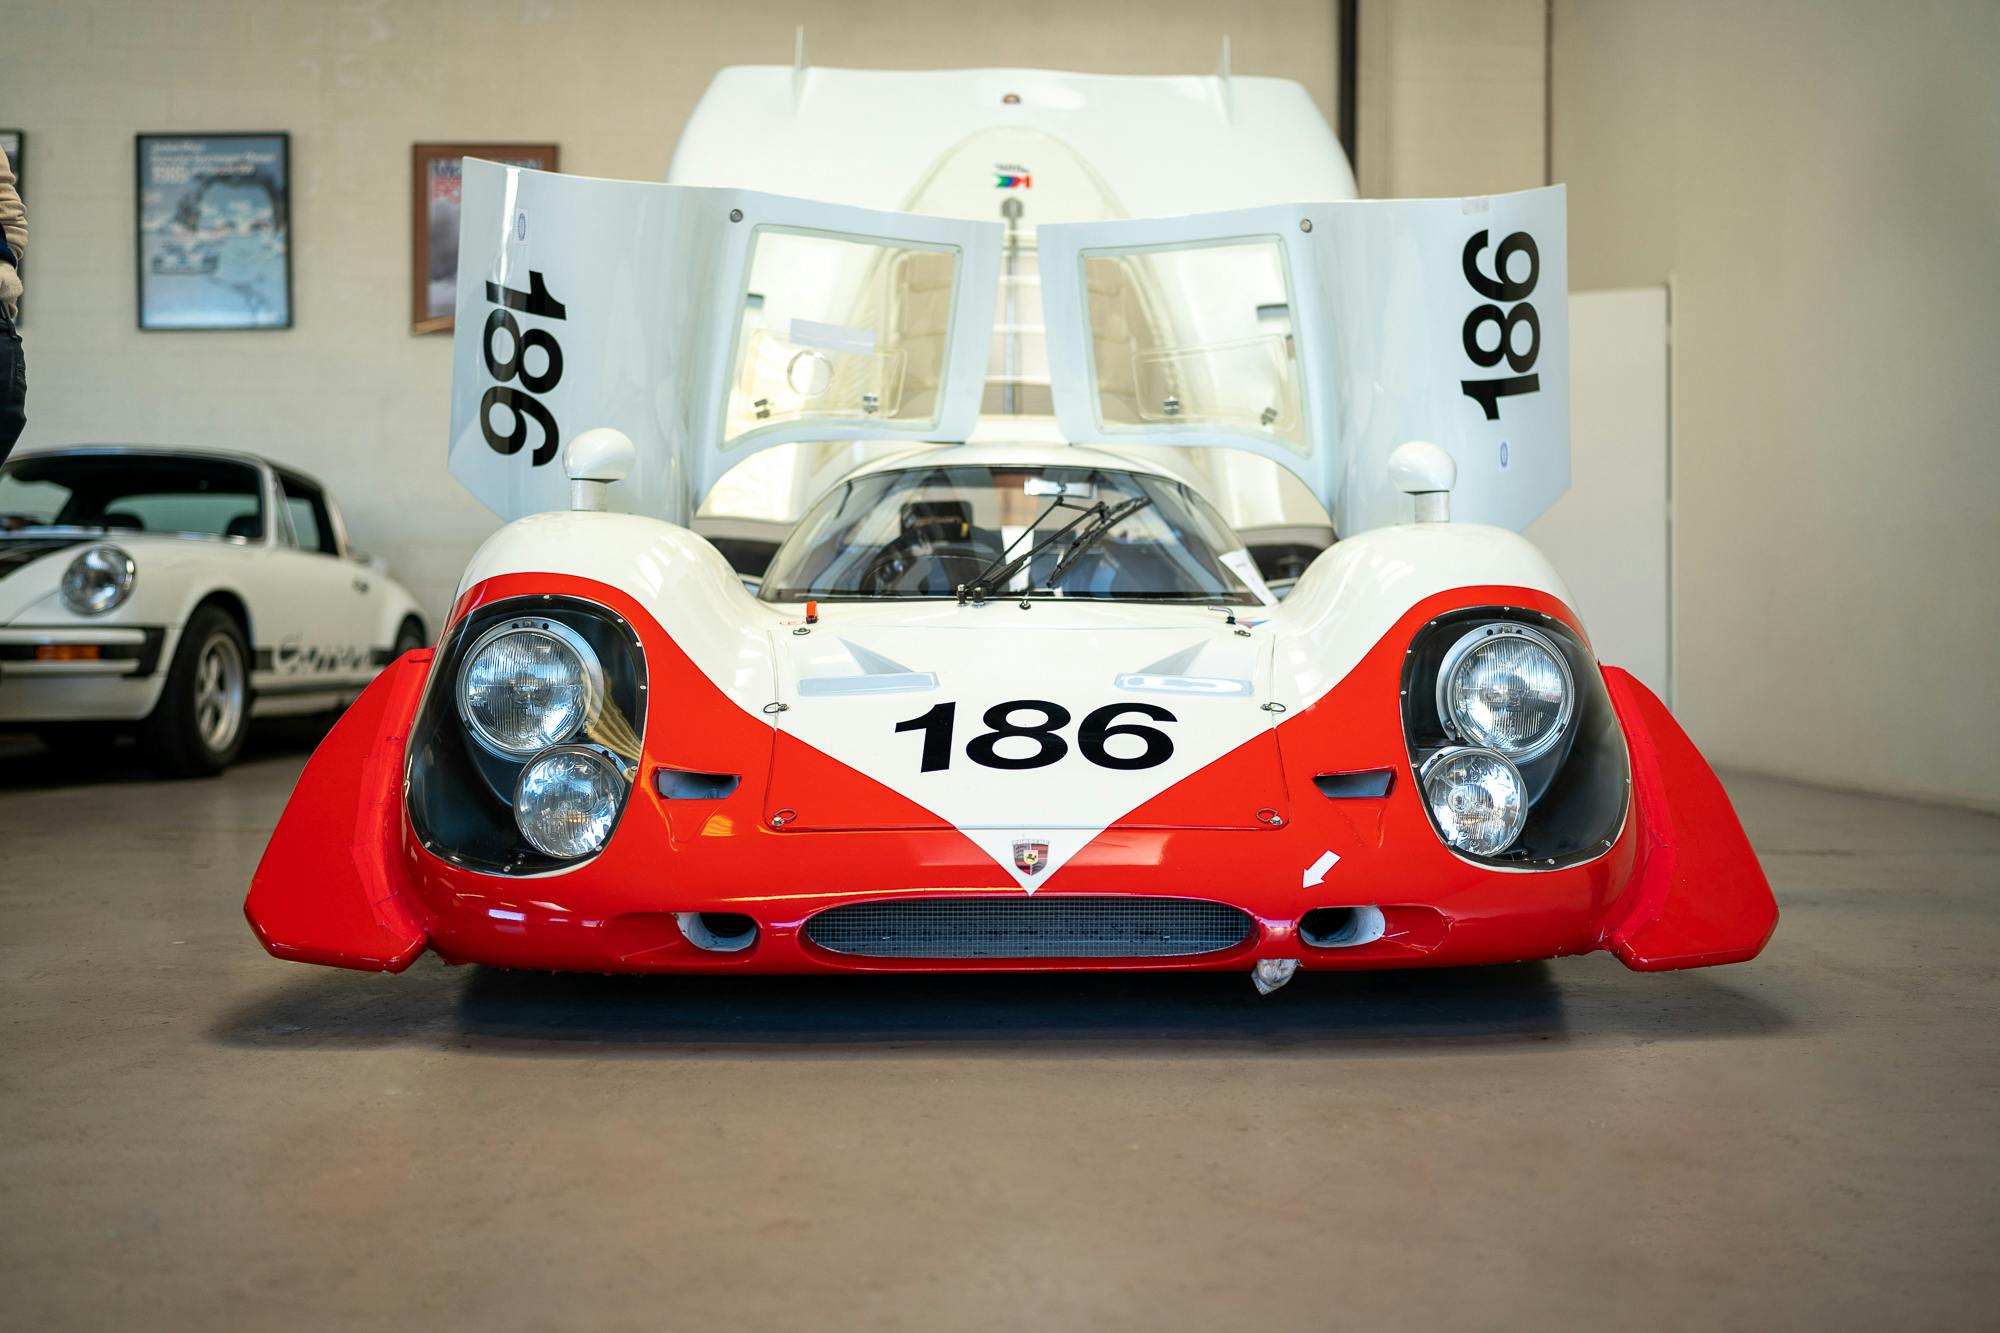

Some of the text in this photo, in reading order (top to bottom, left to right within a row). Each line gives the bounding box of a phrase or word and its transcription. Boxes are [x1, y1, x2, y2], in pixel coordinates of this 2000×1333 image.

[480, 270, 567, 467] 186
[1461, 229, 1541, 421] 186
[894, 699, 1178, 773] 186
